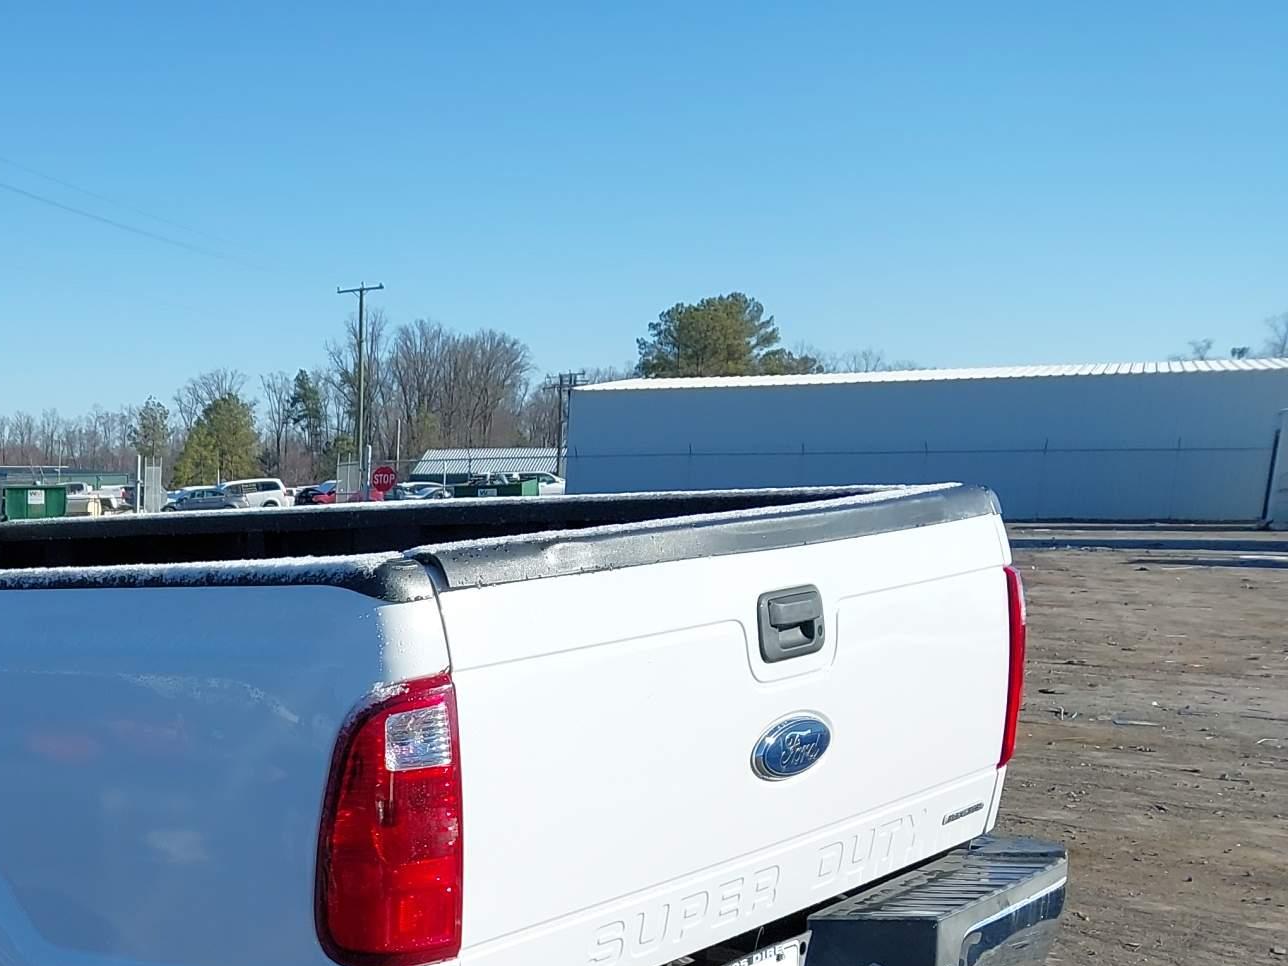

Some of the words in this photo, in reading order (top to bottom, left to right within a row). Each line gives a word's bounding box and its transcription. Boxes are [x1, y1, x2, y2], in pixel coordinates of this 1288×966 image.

[374, 473, 395, 485] STOP
[780, 728, 821, 771] Ford
[812, 808, 929, 890] DUTY
